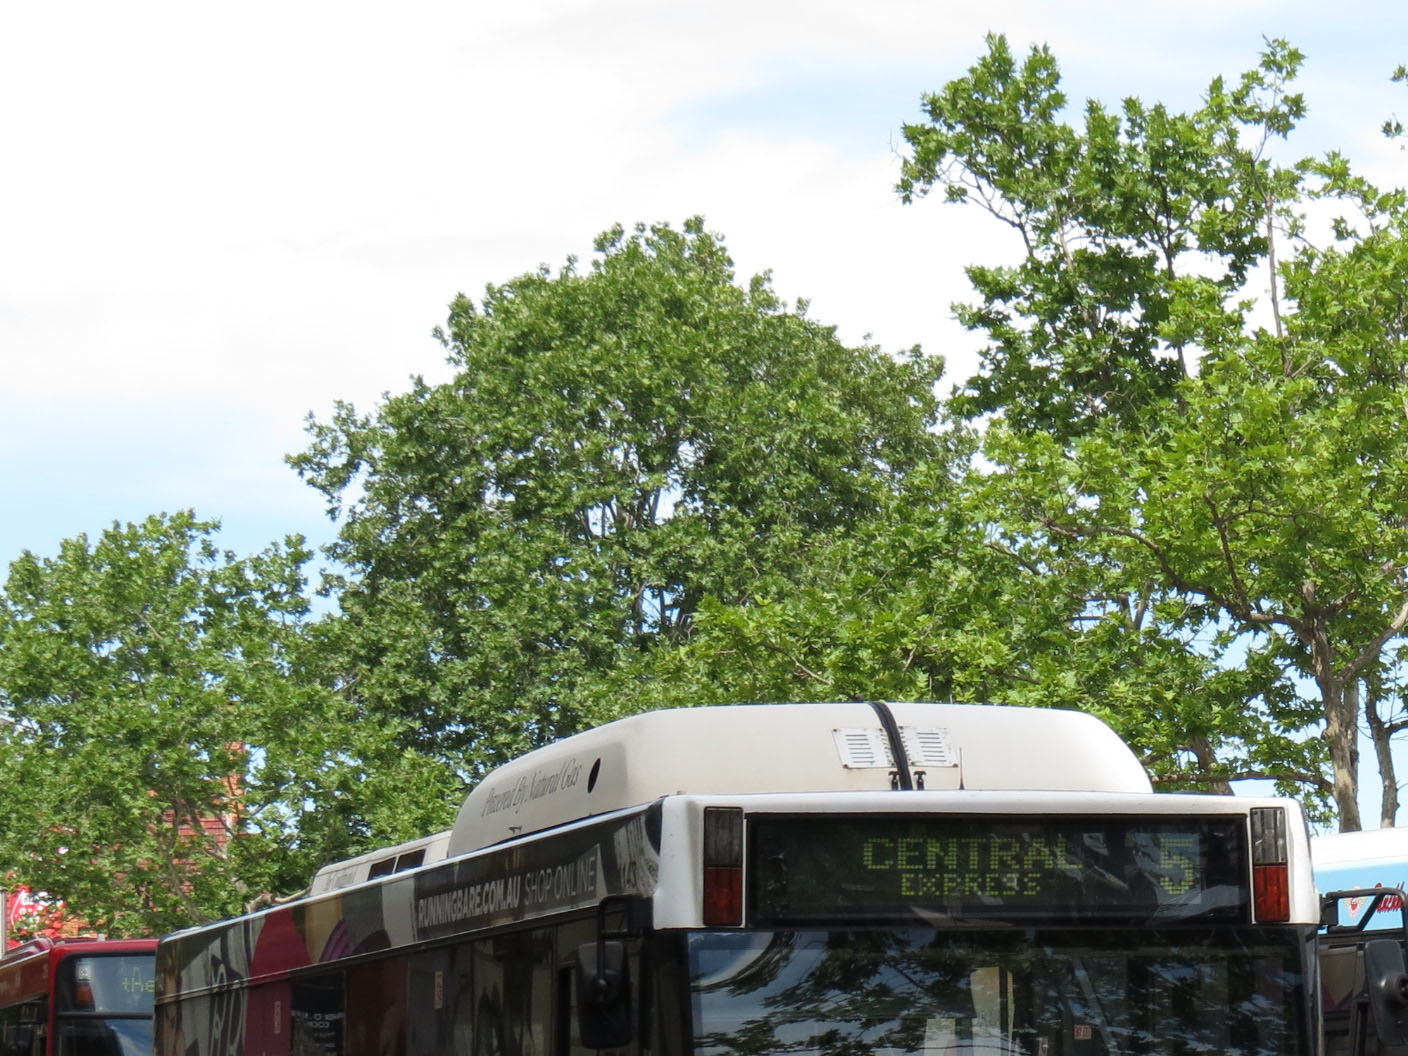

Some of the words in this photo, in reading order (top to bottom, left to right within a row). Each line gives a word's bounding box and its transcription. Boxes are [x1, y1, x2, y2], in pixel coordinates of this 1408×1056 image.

[863, 838, 1084, 869] CENTRAL
[417, 875, 522, 927] RUNNINGBARE.COM.AU
[524, 866, 552, 906] SHOP
[553, 856, 596, 898] ONLINE
[901, 873, 1041, 896] EXPRESS
